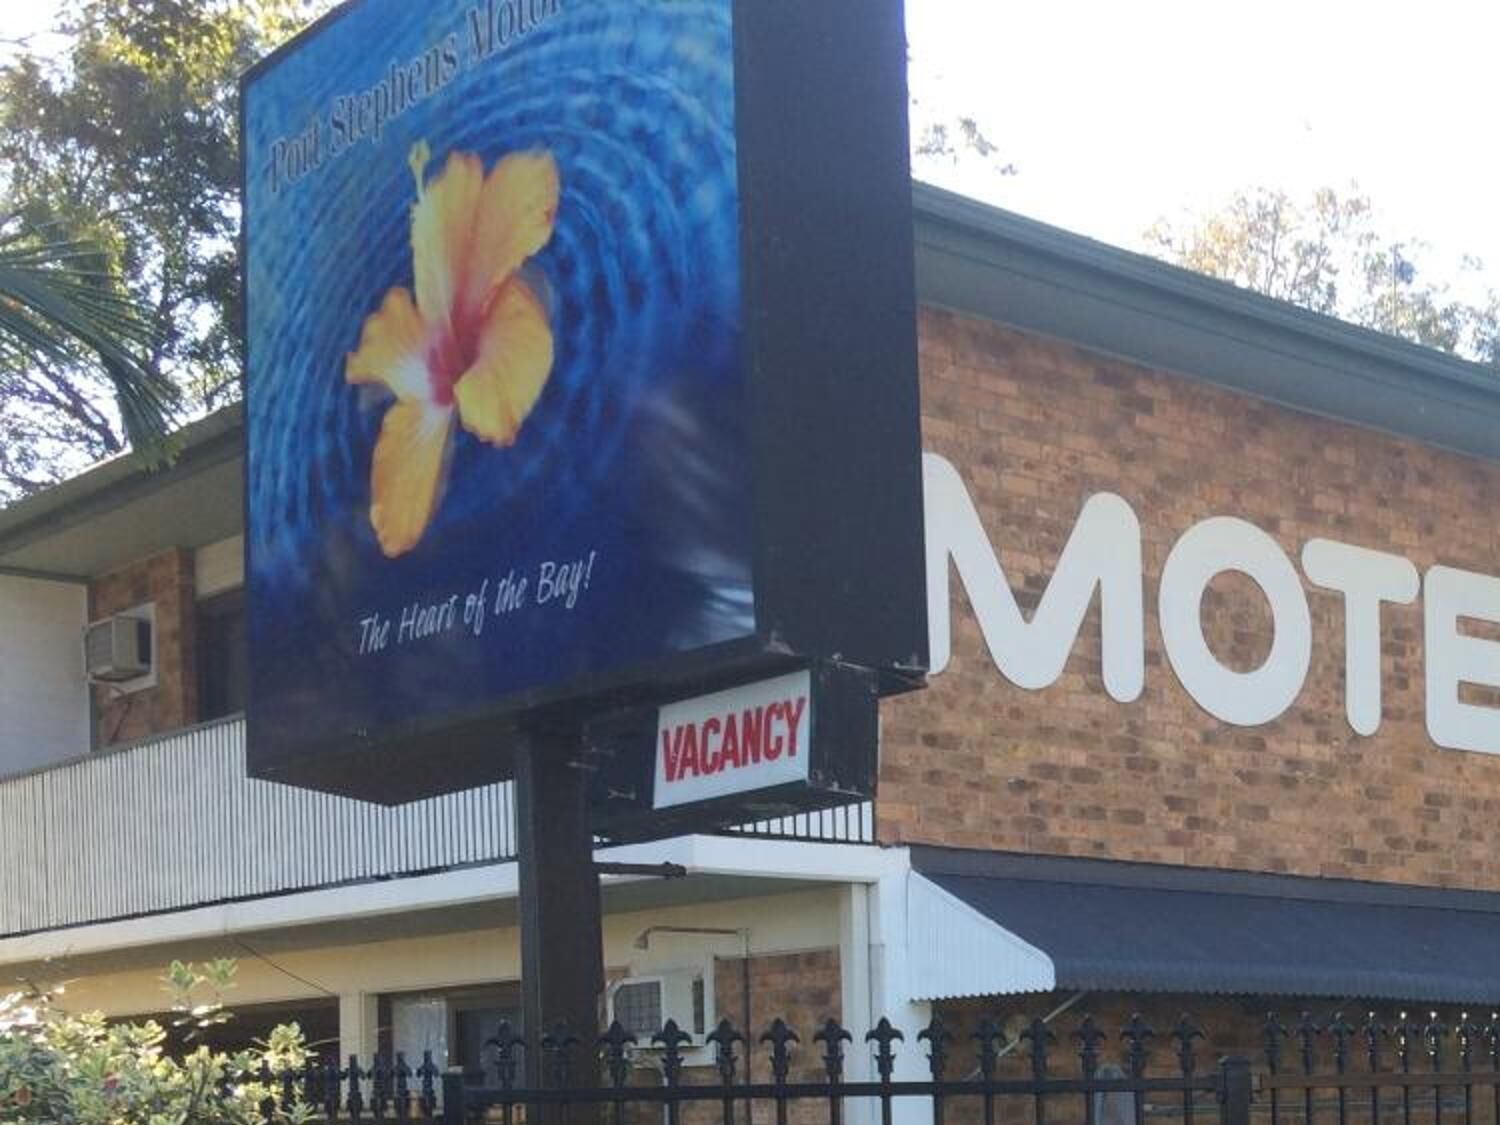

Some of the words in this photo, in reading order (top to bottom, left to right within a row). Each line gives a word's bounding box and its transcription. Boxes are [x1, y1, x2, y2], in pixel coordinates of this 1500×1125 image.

[268, 112, 322, 193] Port
[326, 31, 460, 156] Stephens
[359, 612, 391, 655] The
[397, 594, 459, 643] Heart
[463, 578, 488, 636] of
[494, 568, 529, 615] the
[536, 549, 597, 609] Bay!
[661, 696, 806, 782] VACANCY
